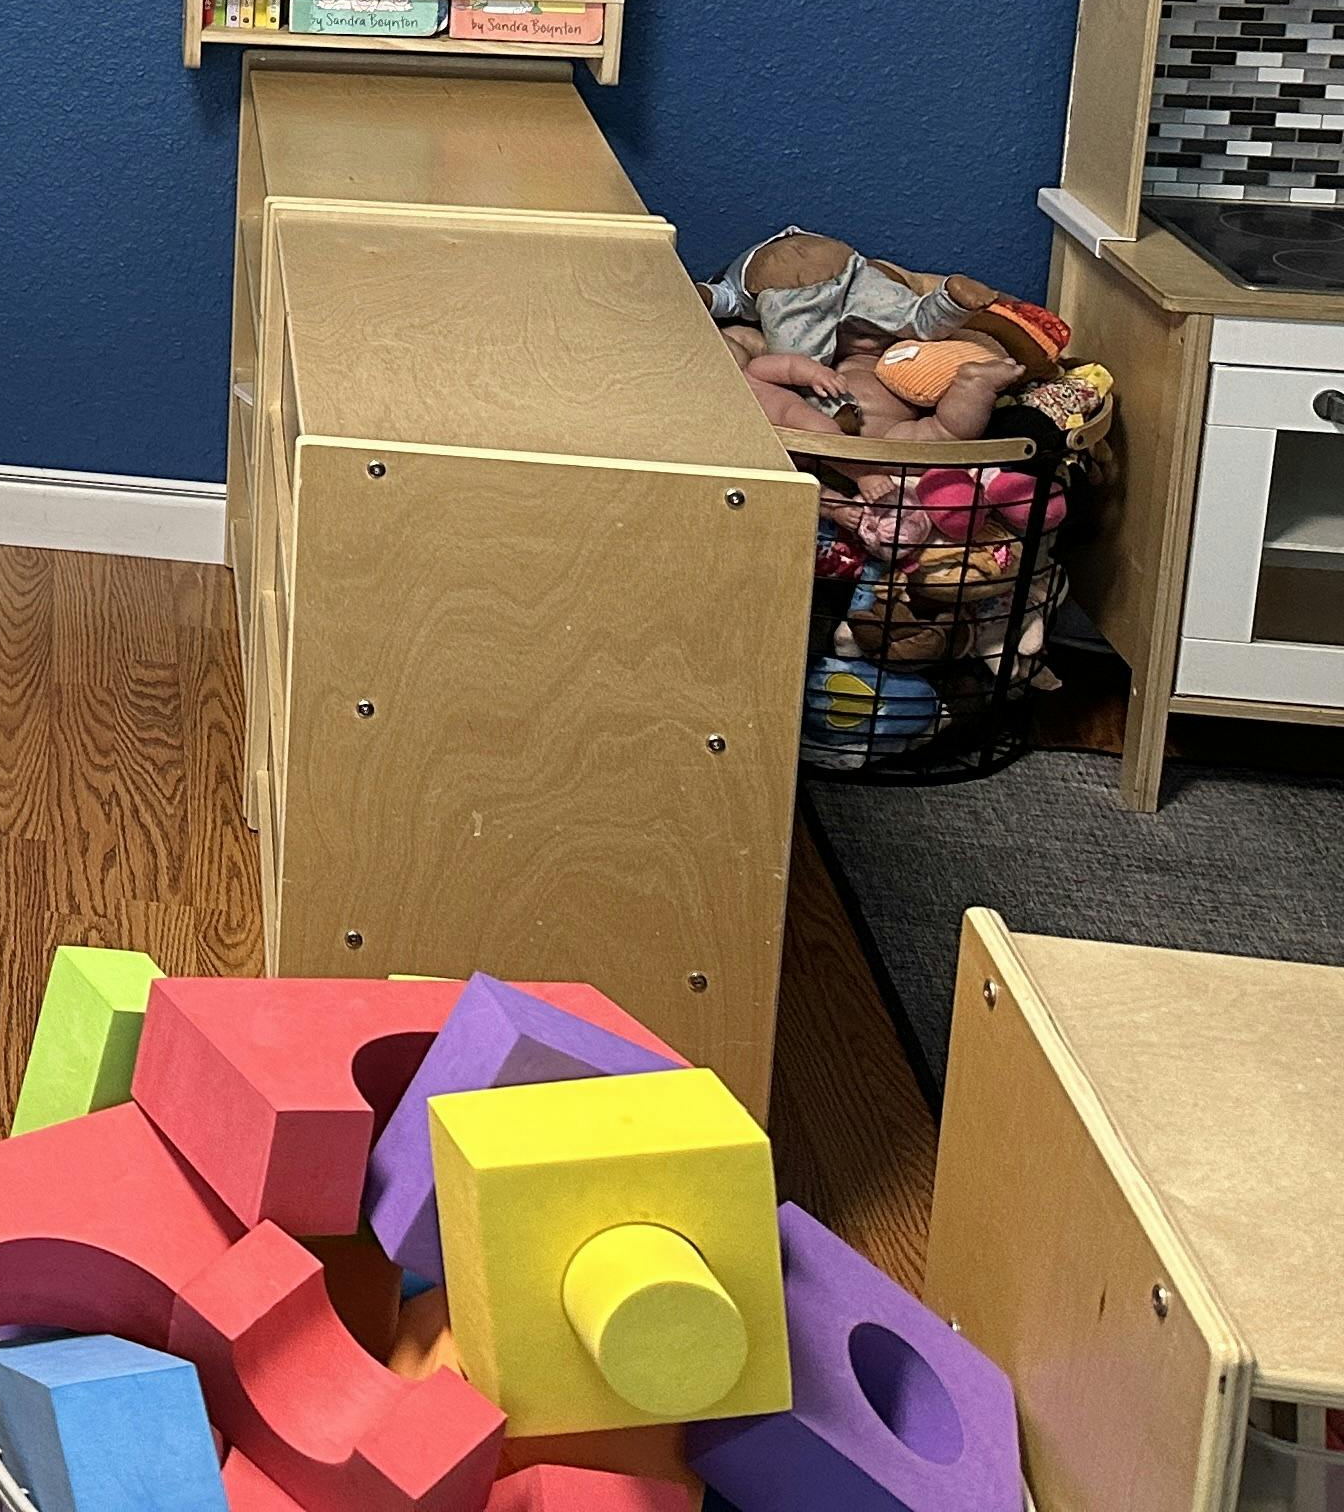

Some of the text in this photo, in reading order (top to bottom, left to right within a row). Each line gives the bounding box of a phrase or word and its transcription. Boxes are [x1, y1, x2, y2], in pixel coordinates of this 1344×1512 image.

[326, 13, 366, 26] Sandra
[368, 13, 418, 29] Boynton
[471, 17, 582, 37] by Sandra Boynton
